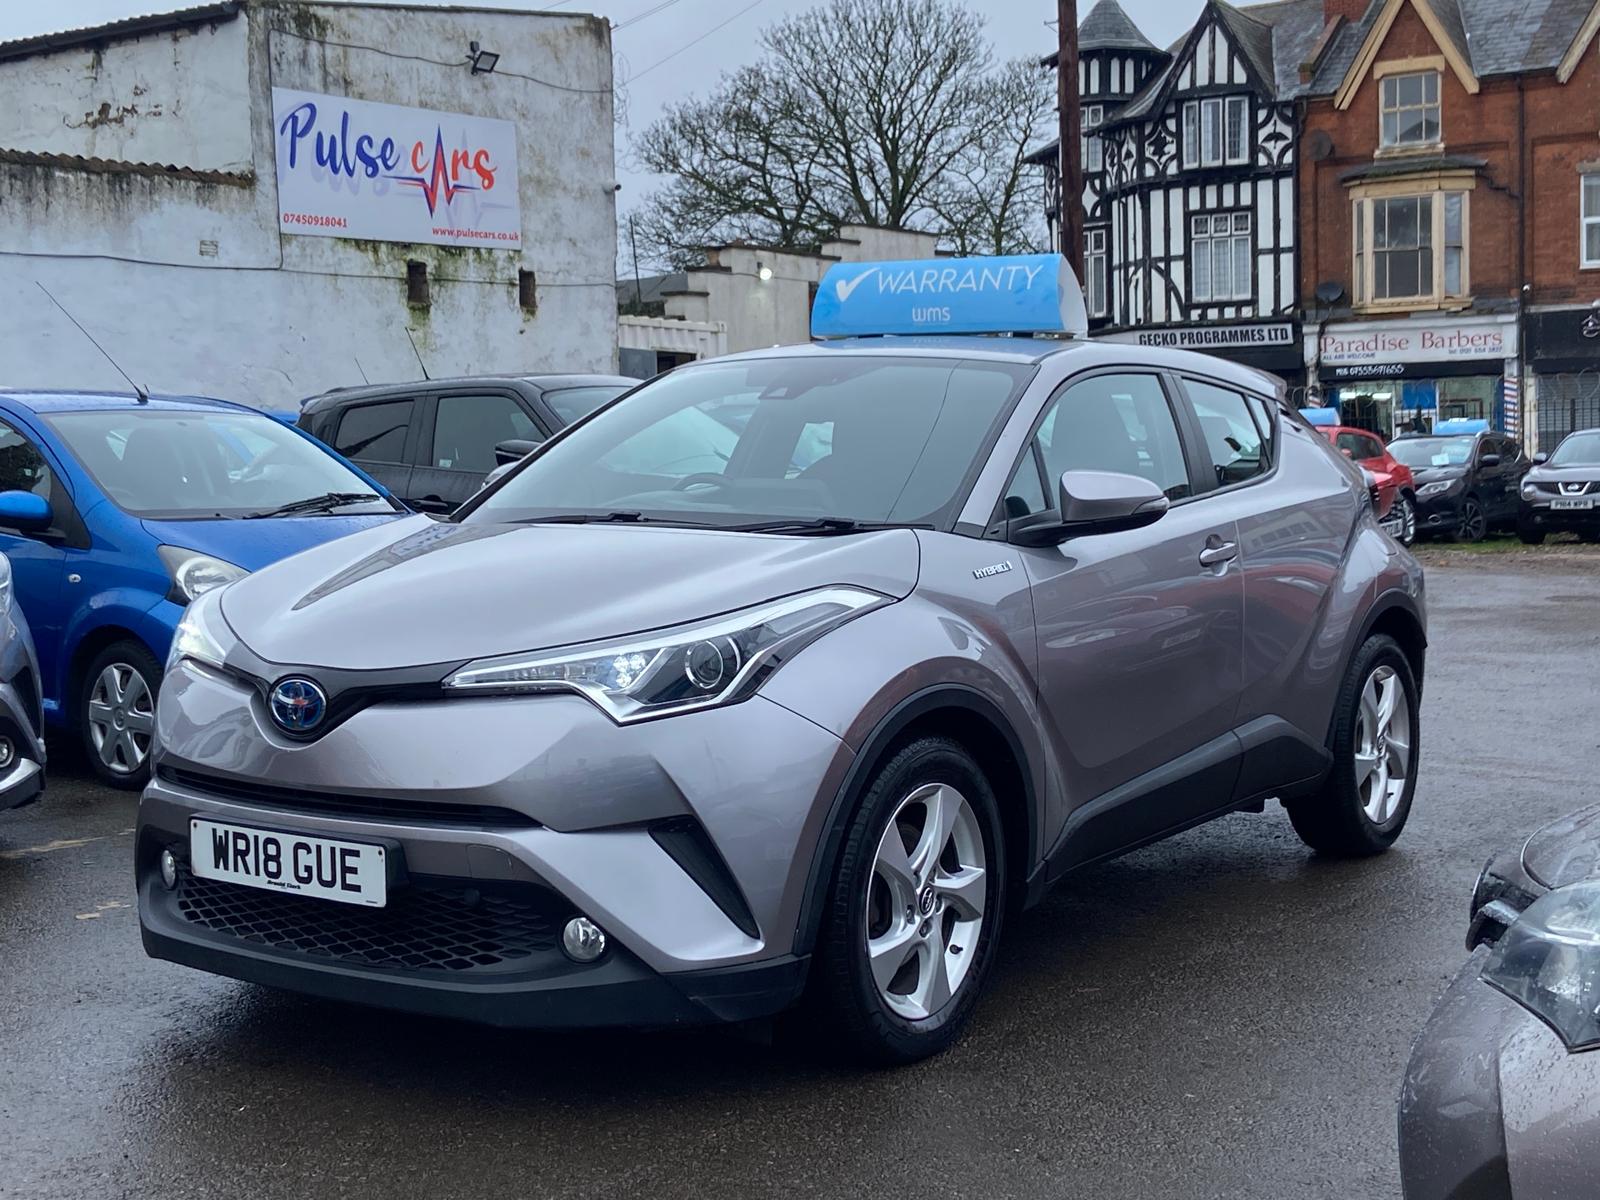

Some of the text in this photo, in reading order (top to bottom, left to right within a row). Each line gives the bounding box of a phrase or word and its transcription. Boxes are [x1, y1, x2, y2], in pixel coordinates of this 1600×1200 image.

[280, 102, 400, 178] Pulse
[283, 212, 348, 228] 07450918041
[432, 226, 519, 241] www.pulsecars.co.uk
[876, 264, 1044, 294] WARRANTY
[912, 306, 950, 322] wms
[1139, 328, 1289, 346] GECKO PROGRAMMES LTD
[1321, 329, 1503, 354] Paradise Barbers
[1347, 352, 1376, 360] WELCOME
[972, 563, 1008, 579] HYBRID
[292, 841, 362, 893] GUE
